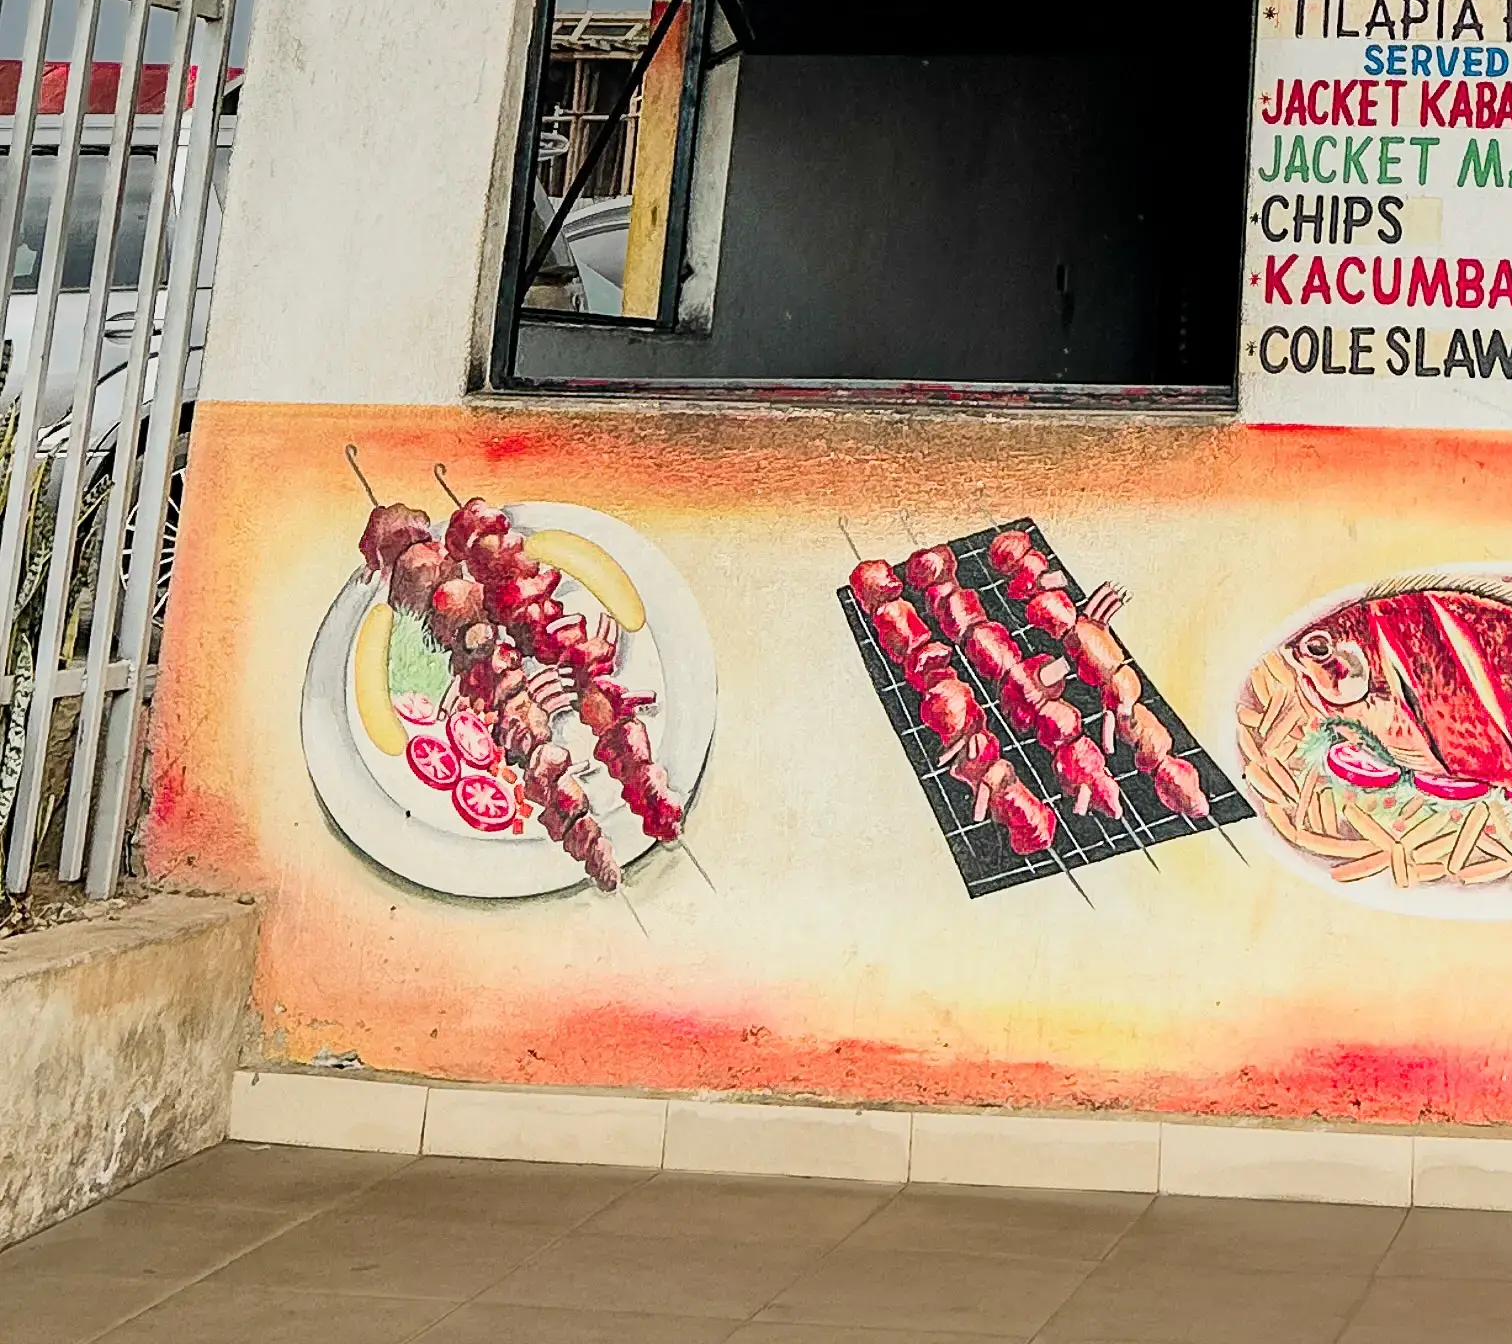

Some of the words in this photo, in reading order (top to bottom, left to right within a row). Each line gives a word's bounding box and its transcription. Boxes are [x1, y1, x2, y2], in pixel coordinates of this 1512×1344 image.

[1364, 44, 1509, 77] SERVED
[1260, 79, 1407, 126] JACKET
[1258, 135, 1440, 185] JACKET
[1260, 194, 1403, 244] CHIPS
